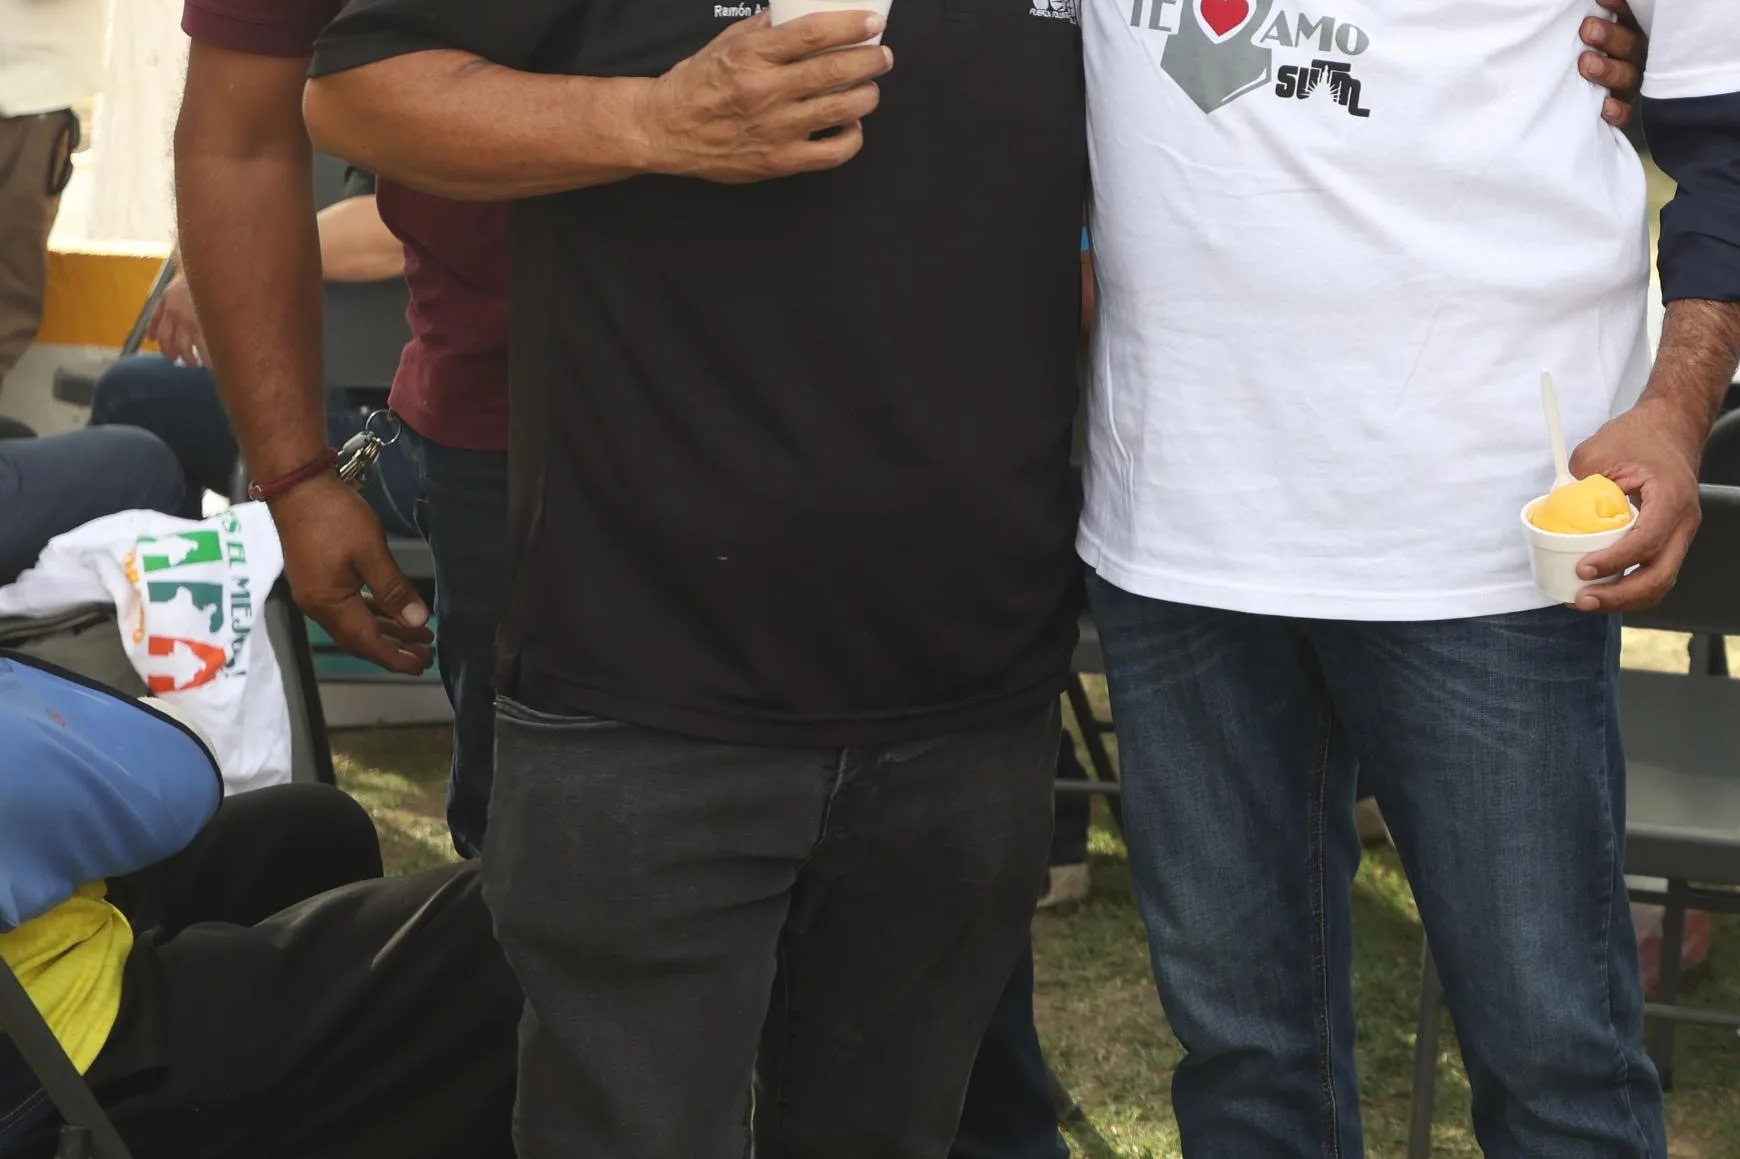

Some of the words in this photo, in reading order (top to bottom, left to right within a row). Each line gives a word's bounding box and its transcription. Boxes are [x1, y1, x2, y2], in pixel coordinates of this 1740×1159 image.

[714, 2, 752, 18] Ramón
[755, 3, 771, 16] A
[1260, 10, 1370, 56] AMO
